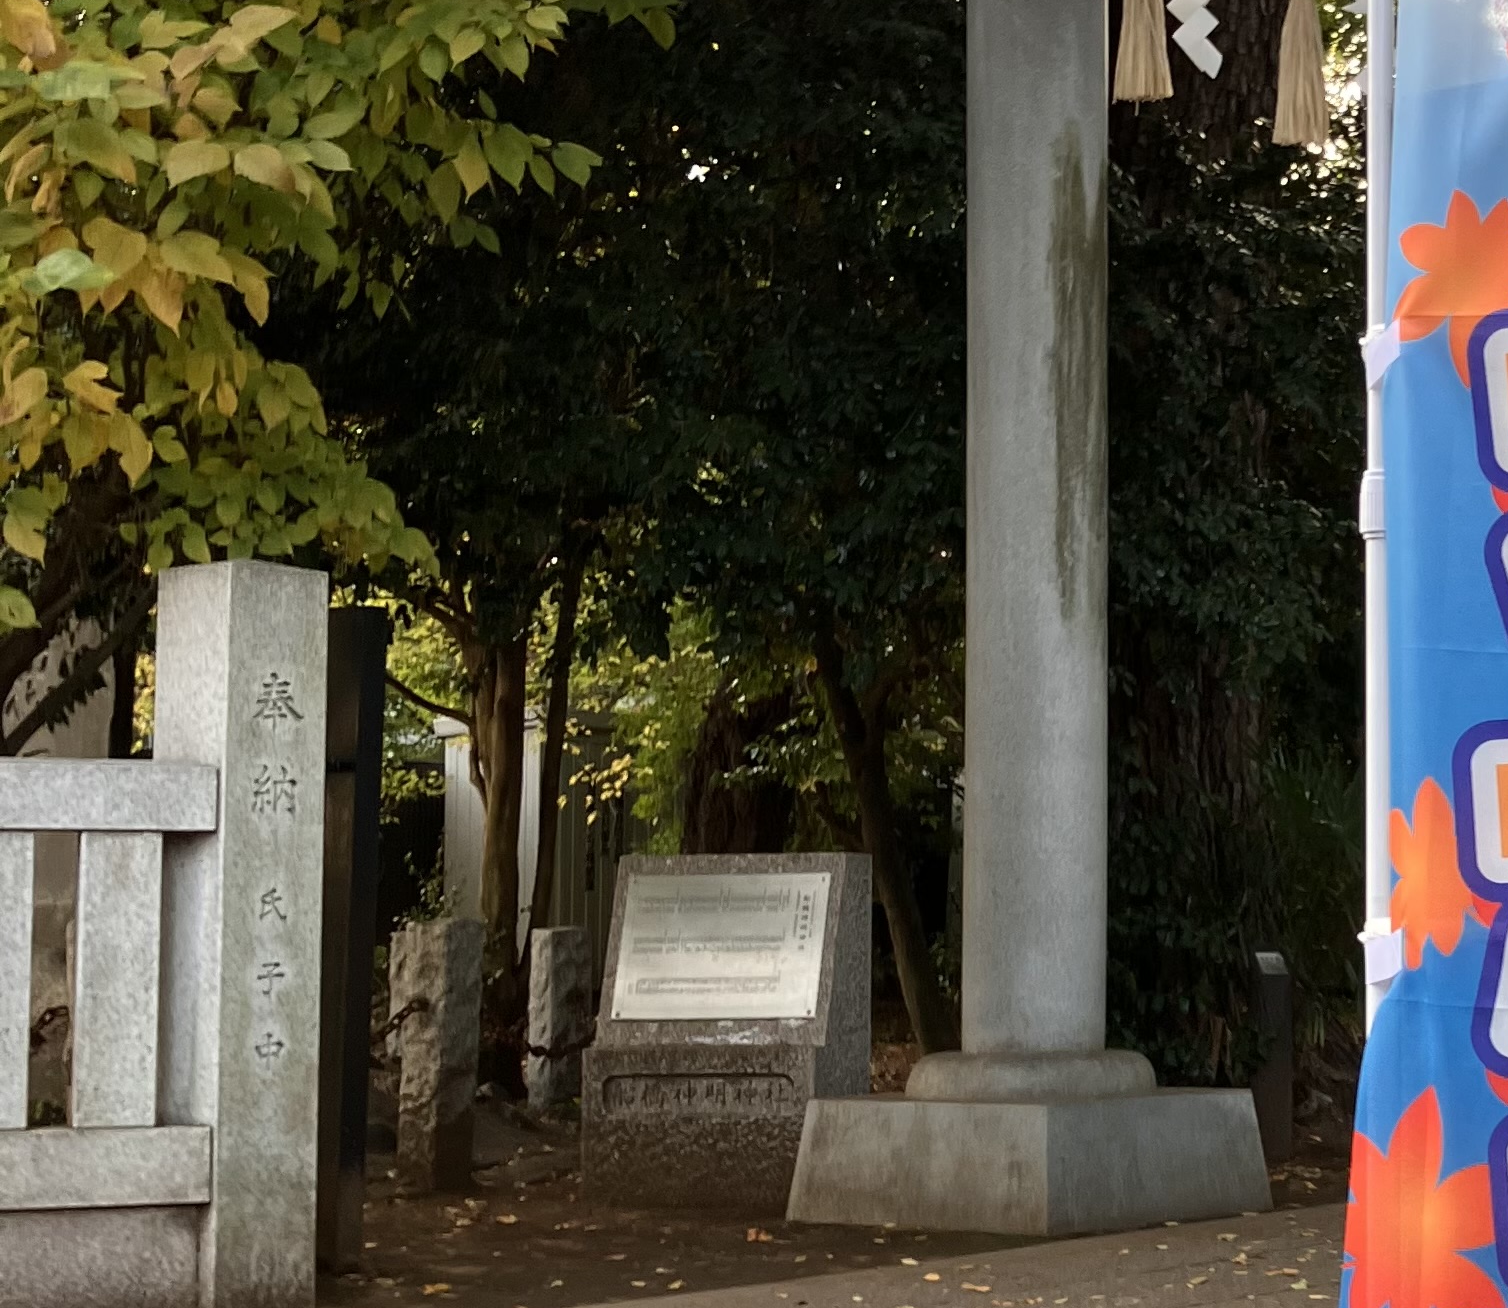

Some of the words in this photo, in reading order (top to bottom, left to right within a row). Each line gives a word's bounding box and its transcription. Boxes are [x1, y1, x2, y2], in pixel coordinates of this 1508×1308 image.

[252, 670, 305, 818] 奉納
[255, 886, 288, 1071] 氏子中
